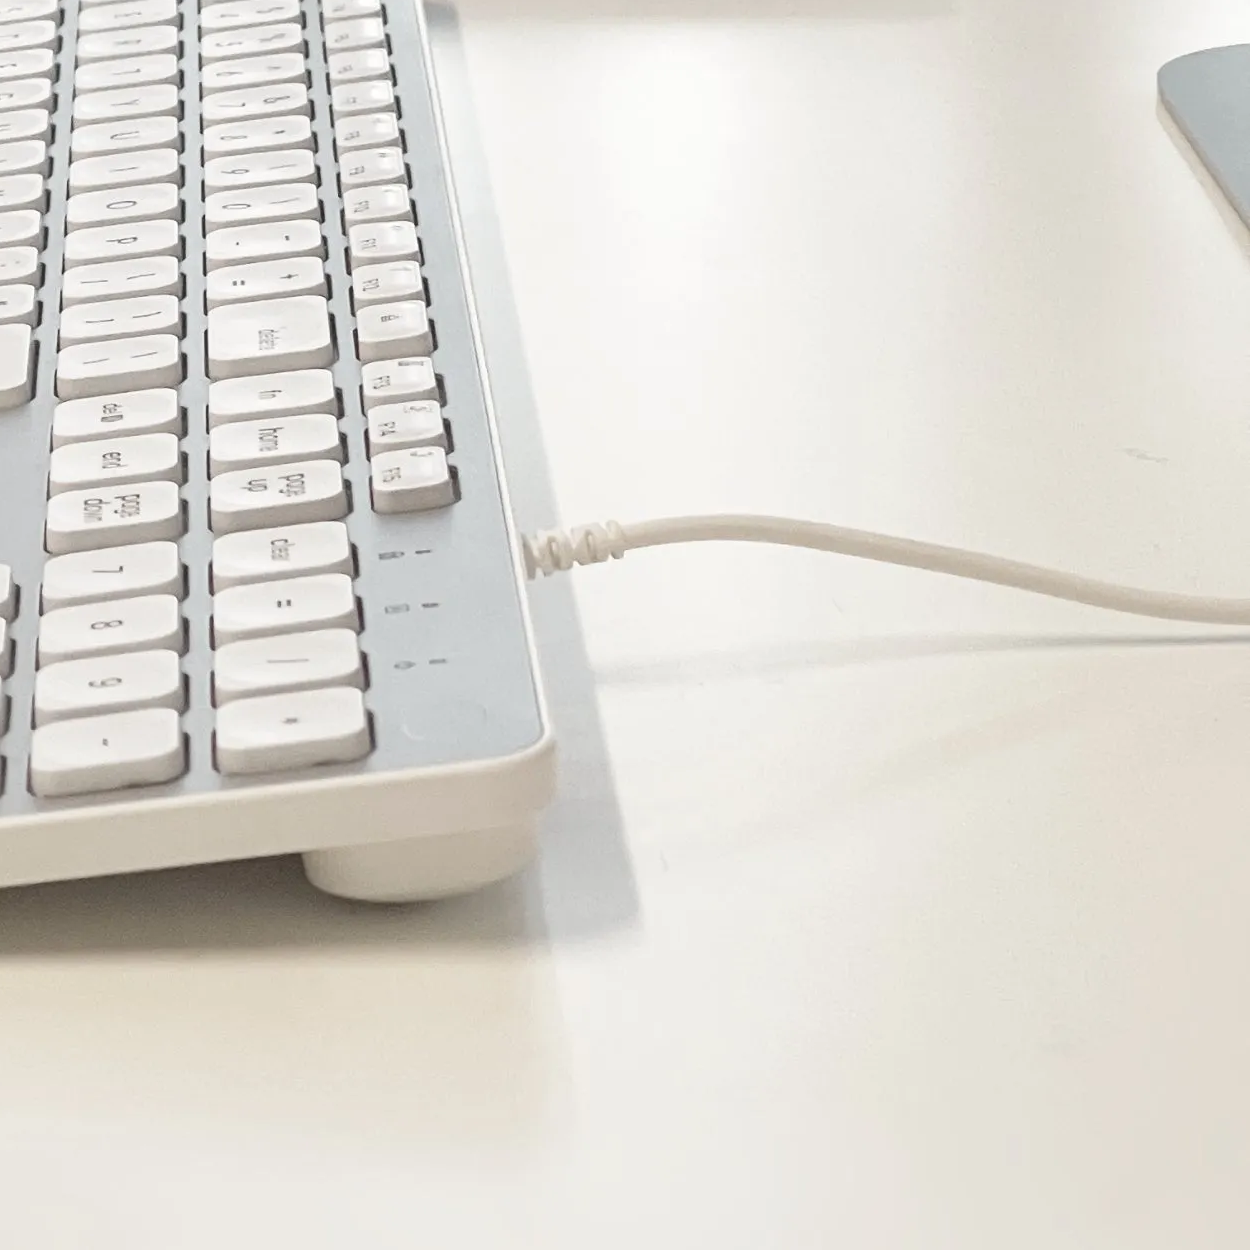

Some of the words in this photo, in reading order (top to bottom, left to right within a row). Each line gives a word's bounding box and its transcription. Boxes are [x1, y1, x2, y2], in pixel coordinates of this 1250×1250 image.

[109, 130, 140, 141] U
[105, 236, 139, 245] P
[259, 389, 282, 399] fn
[259, 427, 283, 451] home
[102, 452, 125, 469] end
[242, 478, 268, 493] up
[90, 619, 124, 631] 8
